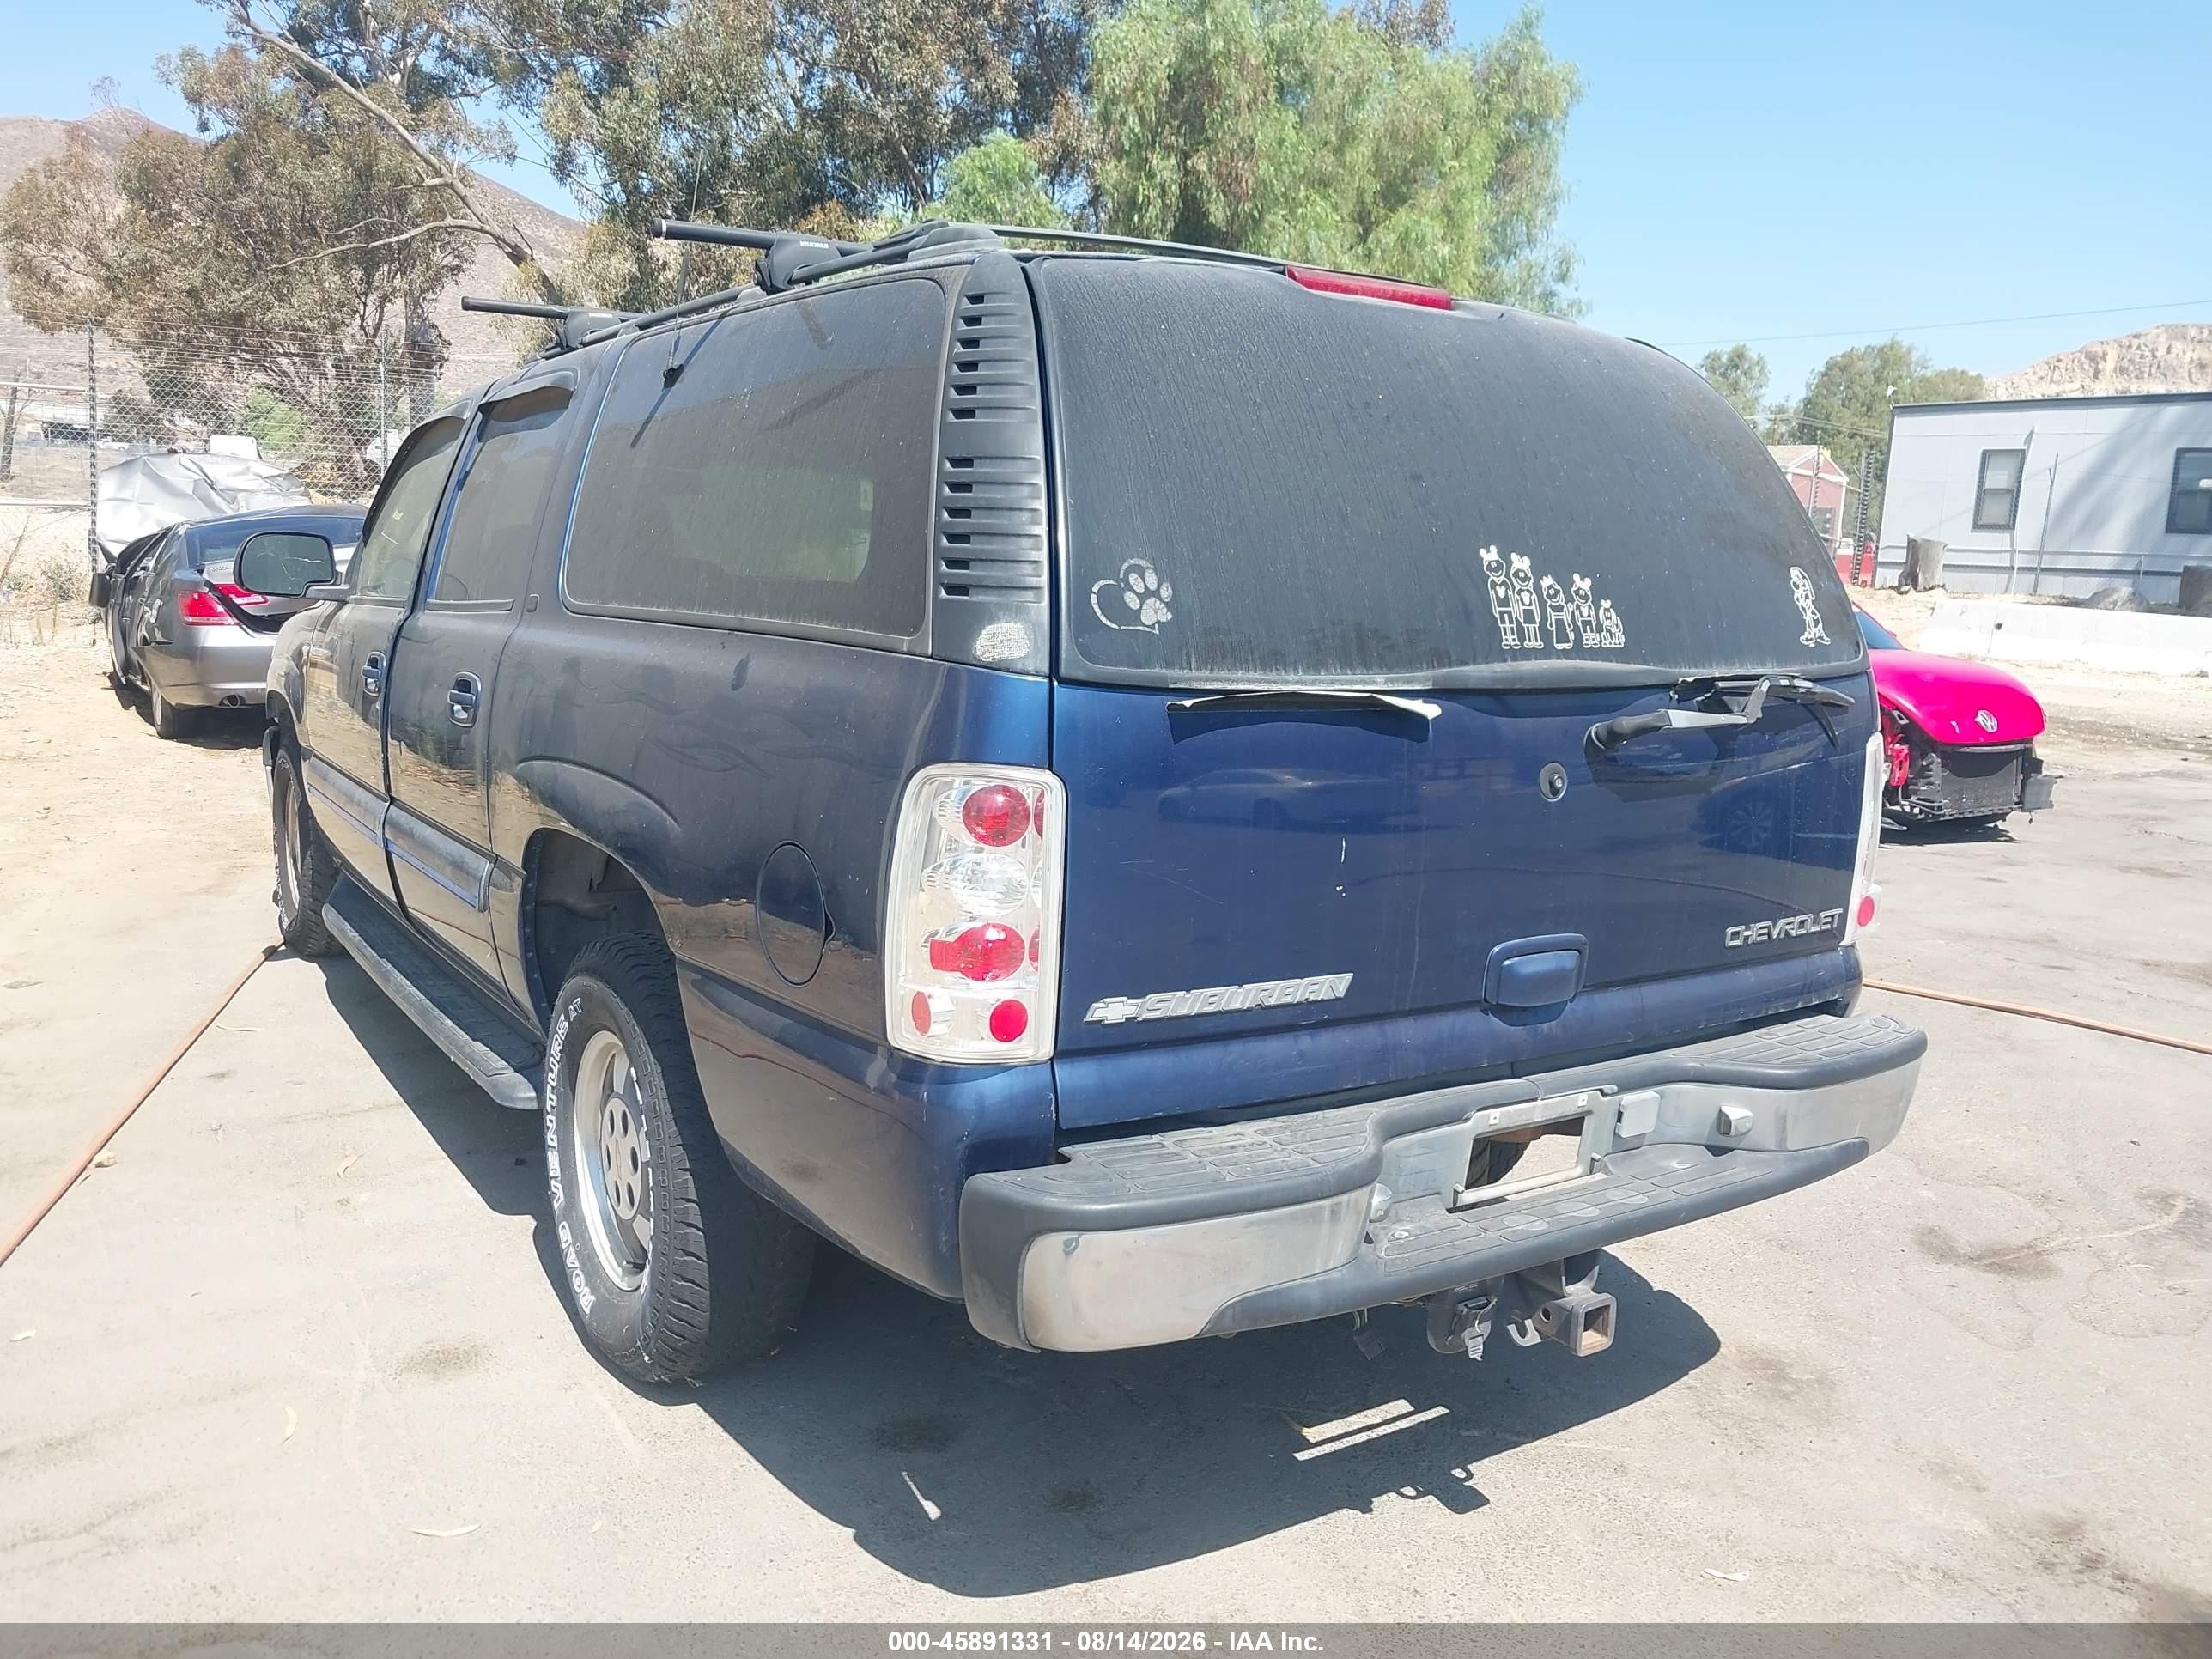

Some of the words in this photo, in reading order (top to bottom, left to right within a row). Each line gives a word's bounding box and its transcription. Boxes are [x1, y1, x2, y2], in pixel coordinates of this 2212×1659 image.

[1725, 908, 1844, 948] CHEVROLET
[568, 997, 584, 1022] AT
[1137, 973, 1354, 1023] SUBURBAN
[545, 1013, 568, 1211] VENTURE
[558, 1221, 596, 1315] ROAD
